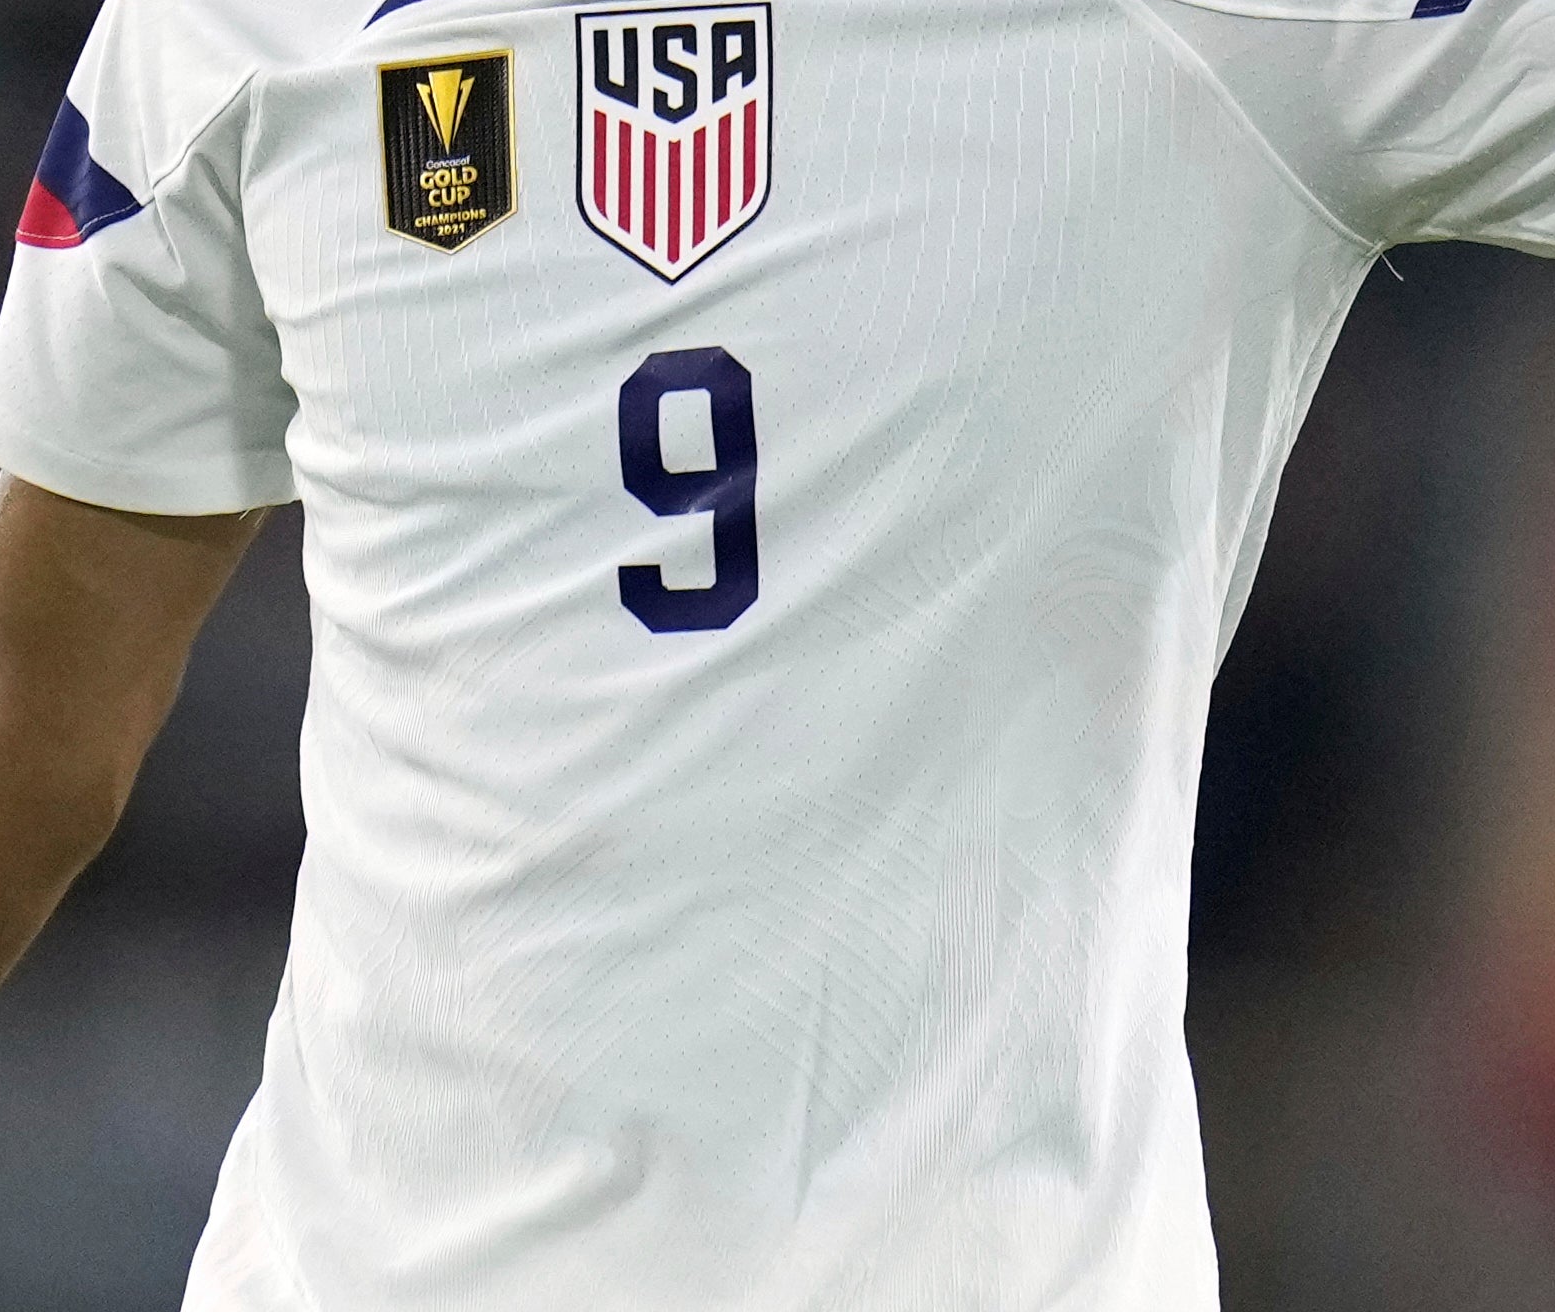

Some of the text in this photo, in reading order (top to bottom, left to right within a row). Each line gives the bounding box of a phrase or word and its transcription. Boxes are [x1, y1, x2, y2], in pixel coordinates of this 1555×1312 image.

[593, 20, 756, 124] USA
[420, 166, 478, 189] GOLD
[428, 186, 470, 207] CUP
[415, 209, 486, 227] CHAMPIONS
[437, 224, 465, 236] 2021
[618, 346, 759, 634] 9
